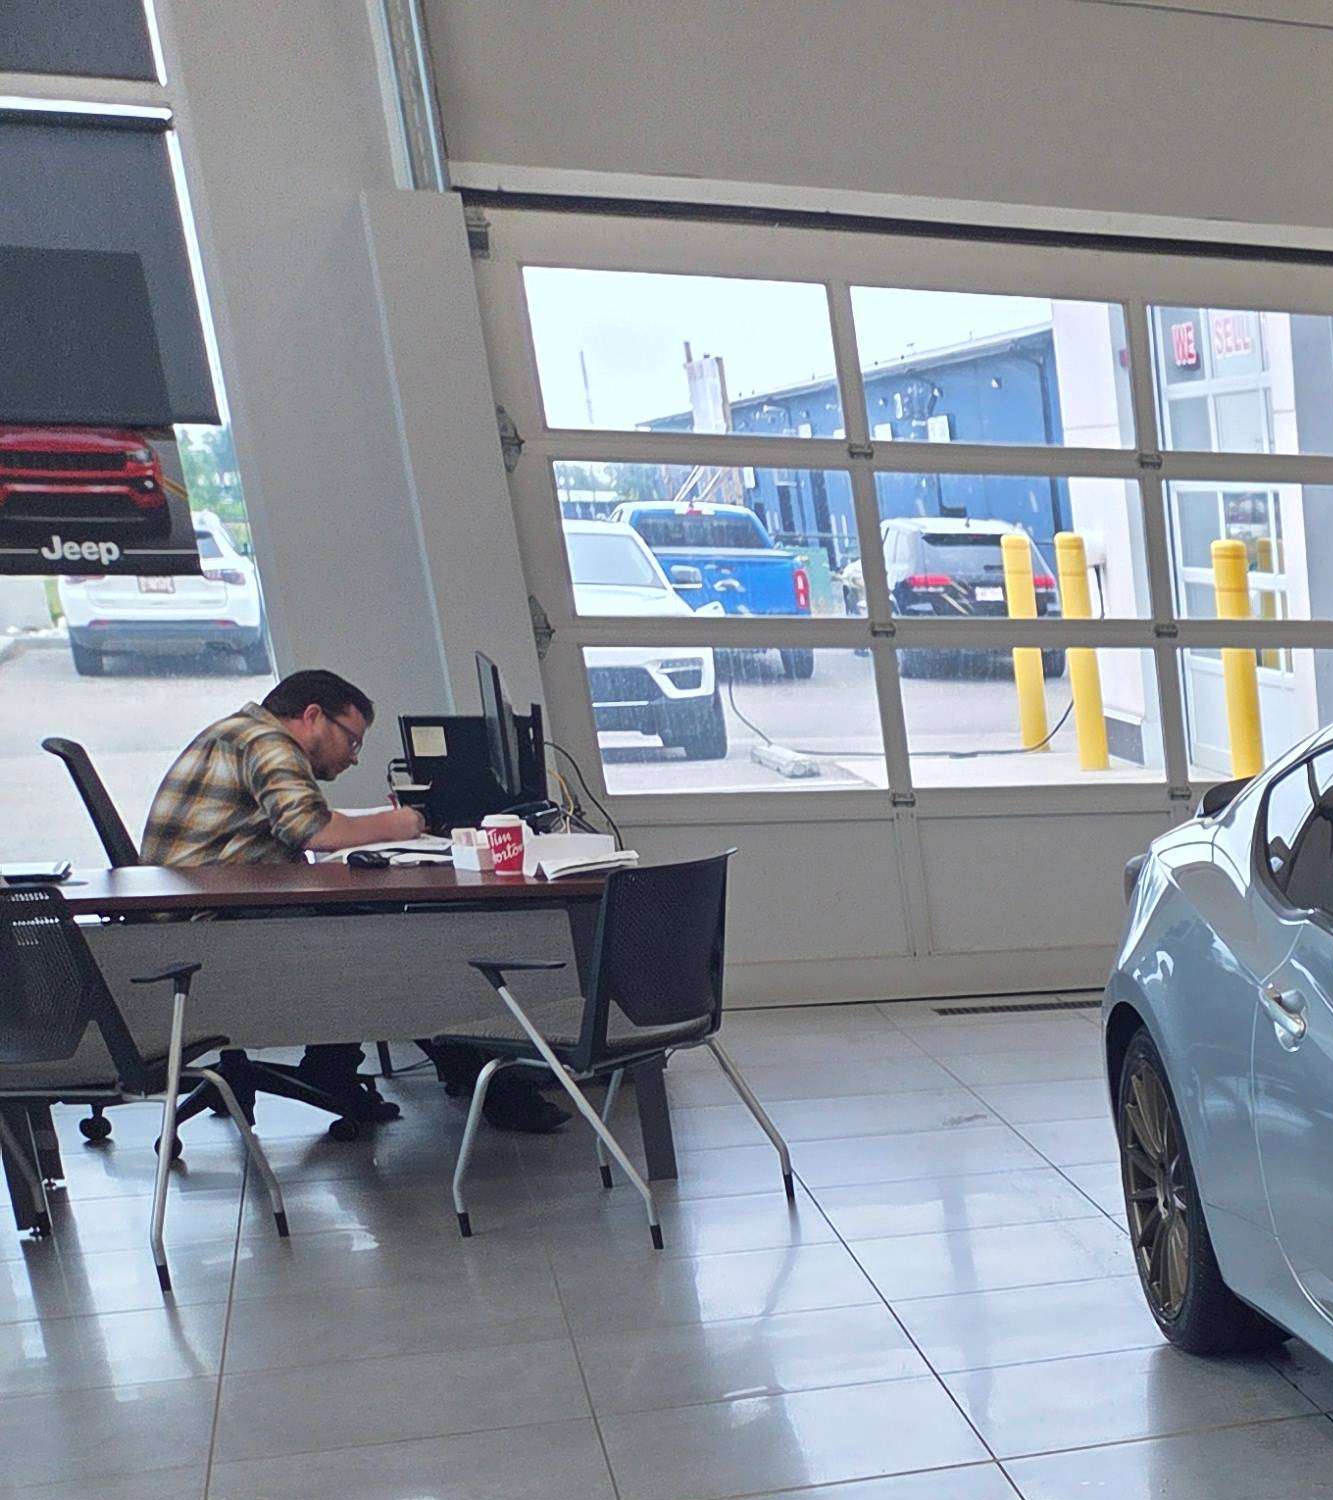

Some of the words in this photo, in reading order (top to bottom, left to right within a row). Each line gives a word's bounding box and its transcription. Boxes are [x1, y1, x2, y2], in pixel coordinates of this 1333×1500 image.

[1171, 321, 1197, 366] WE
[1213, 315, 1252, 360] SELL
[40, 535, 121, 566] Jeep
[488, 829, 512, 849] Tim
